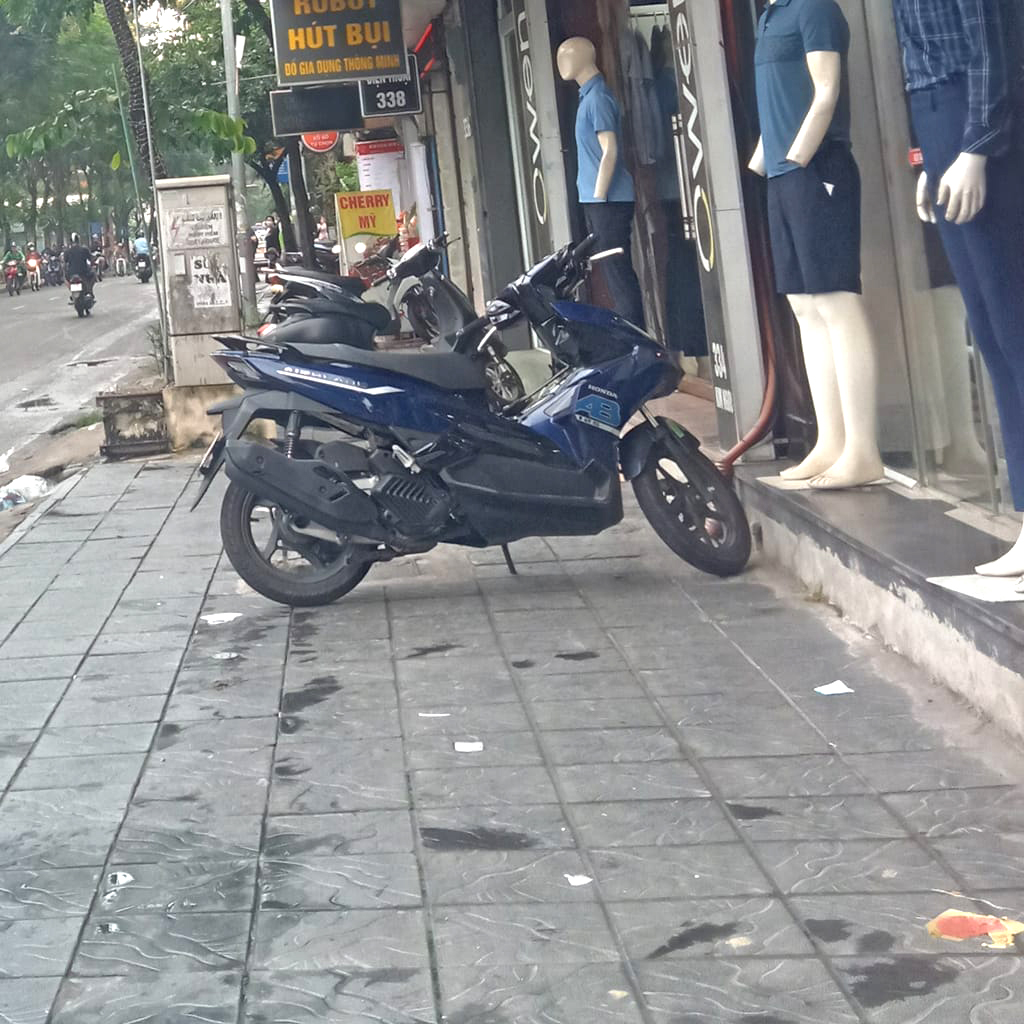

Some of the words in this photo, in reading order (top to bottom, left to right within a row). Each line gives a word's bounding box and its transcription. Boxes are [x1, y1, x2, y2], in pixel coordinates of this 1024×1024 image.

[288, 21, 337, 51] HÚT
[346, 20, 391, 49] BỤI
[376, 90, 406, 109] 338
[339, 194, 389, 209] CHERRY
[587, 384, 618, 400] HONDA
